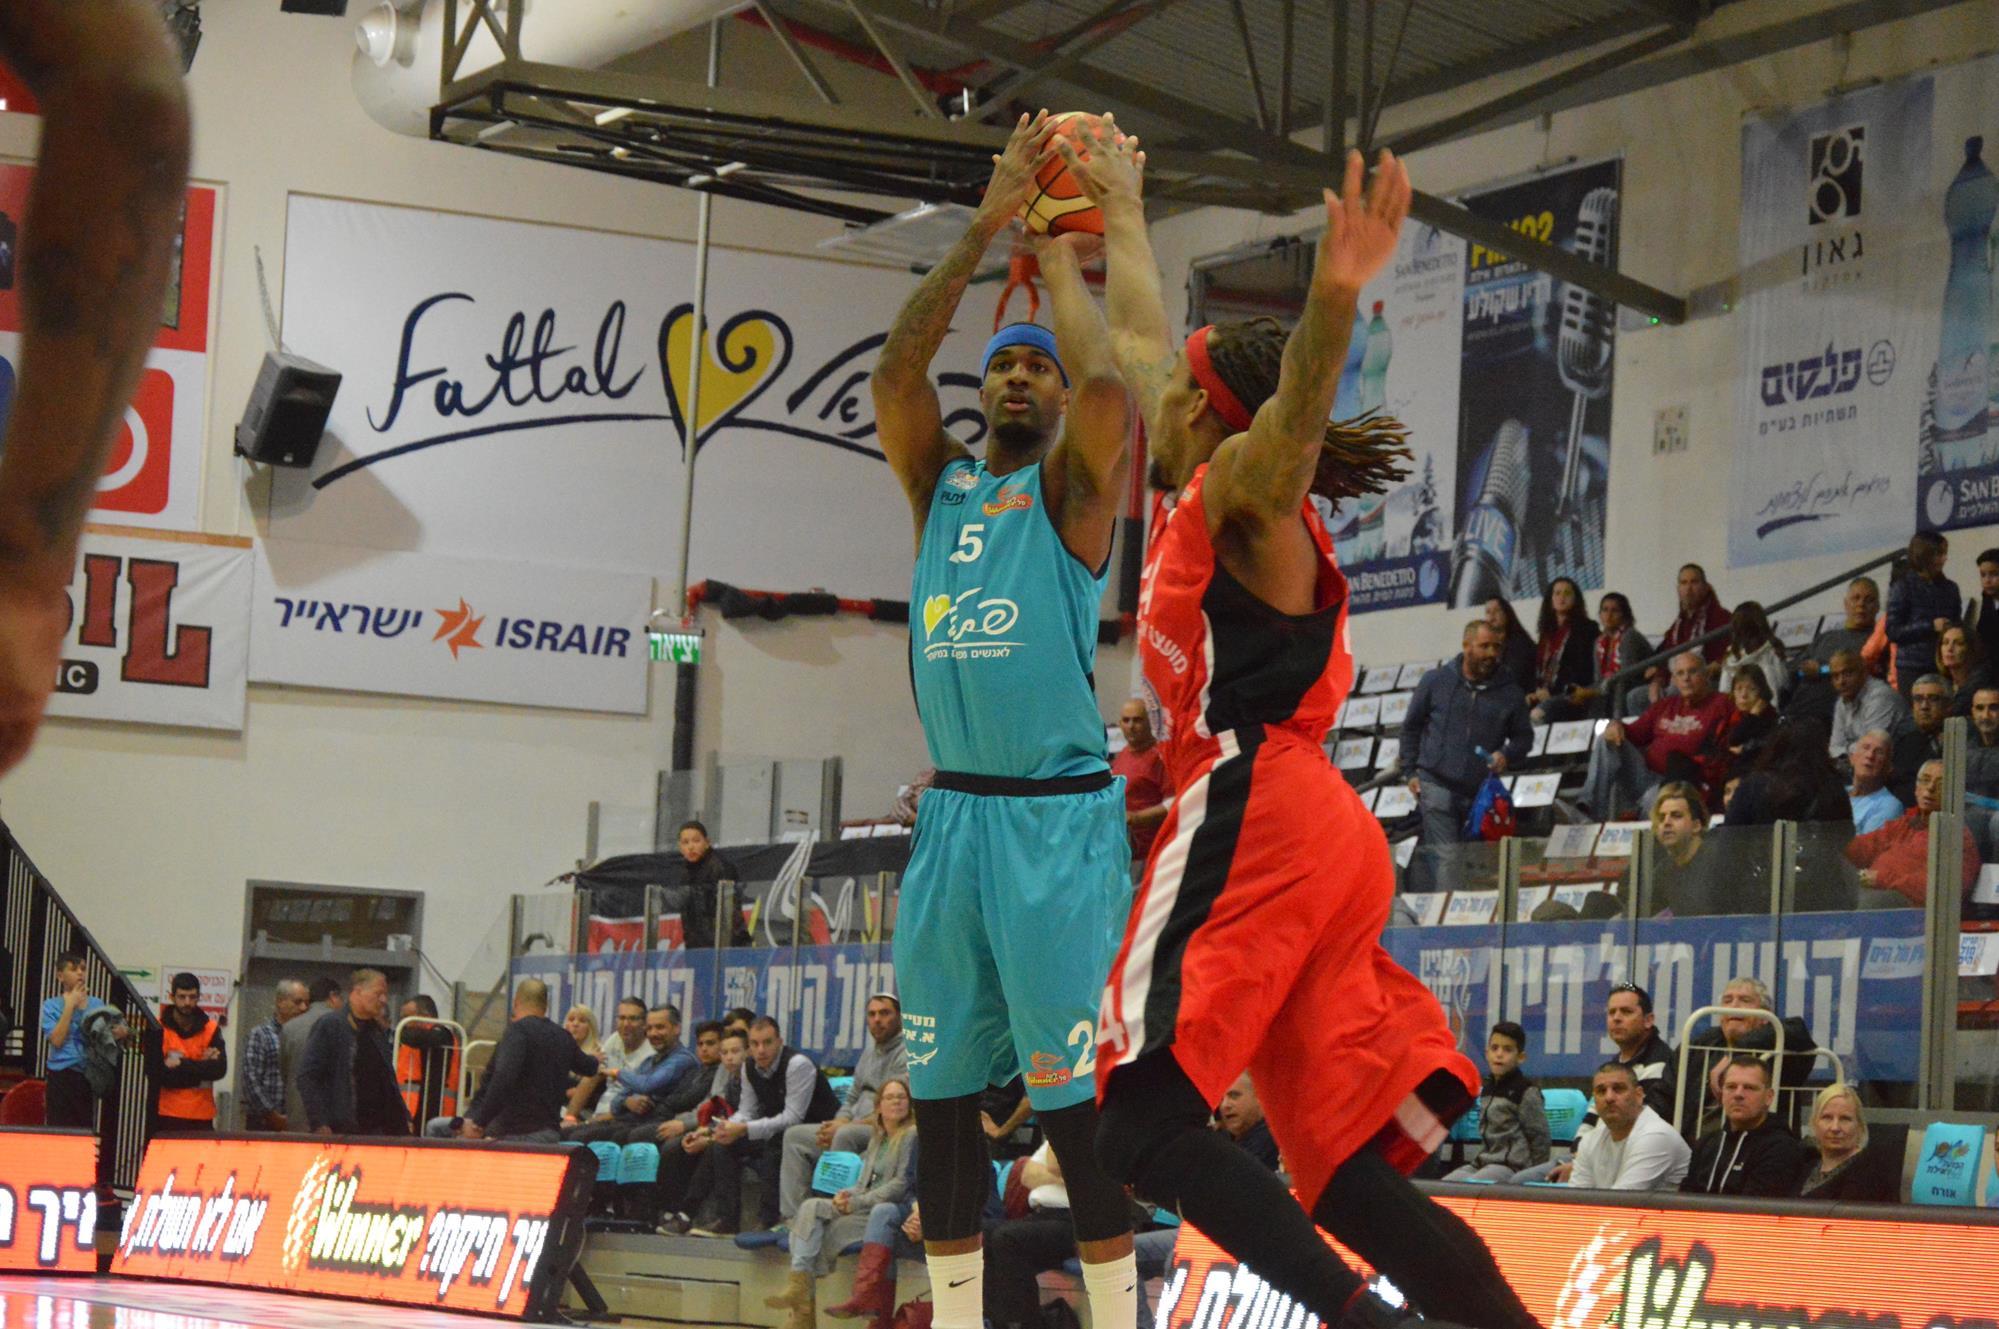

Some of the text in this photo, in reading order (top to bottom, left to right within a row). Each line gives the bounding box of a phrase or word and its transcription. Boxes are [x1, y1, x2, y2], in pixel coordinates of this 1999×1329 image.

[1802, 231, 1864, 275] גאון
[366, 292, 648, 433] Fattal
[949, 523, 985, 564] 5
[66, 553, 212, 689] IL
[274, 597, 423, 639] ישראייר
[495, 617, 631, 658] ISRAIR
[649, 632, 700, 663] יציאה
[311, 1172, 425, 1268] Winner
